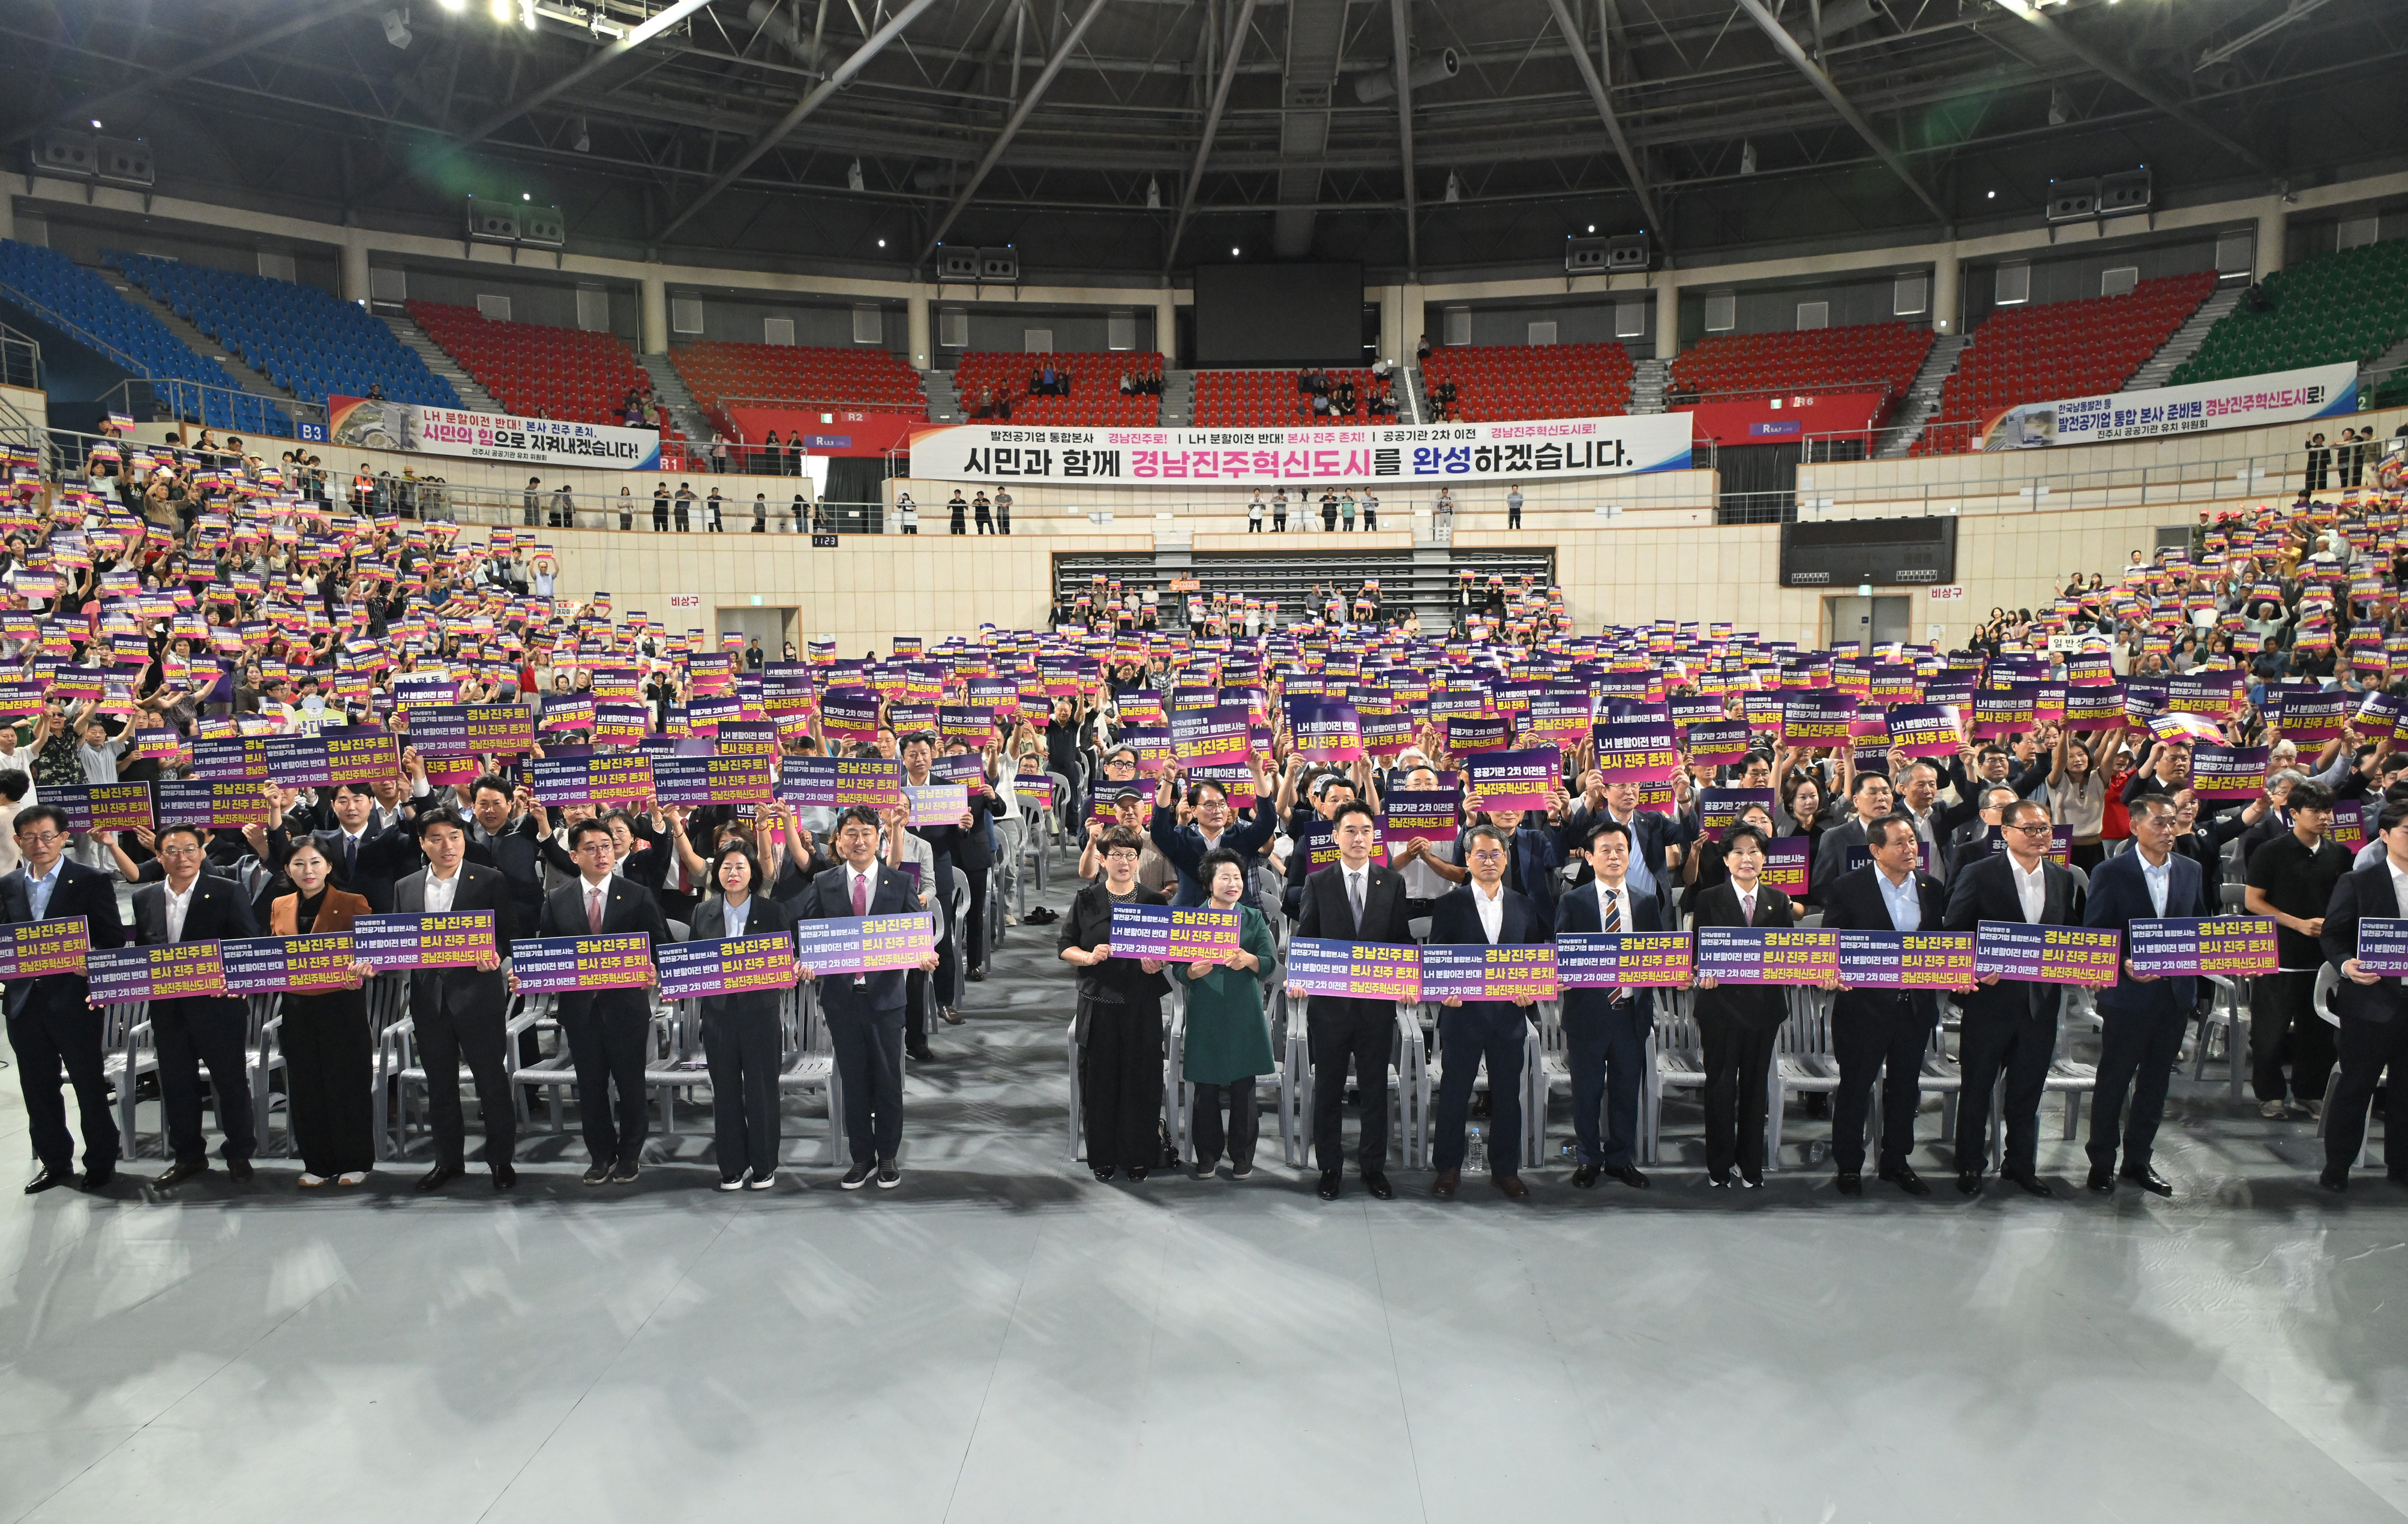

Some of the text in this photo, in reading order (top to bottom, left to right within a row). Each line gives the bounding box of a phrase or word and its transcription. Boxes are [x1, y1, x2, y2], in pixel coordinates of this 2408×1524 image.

[2059, 400, 2111, 413] 한국남동발전 등
[2059, 386, 2324, 433] 발전공기업 통합 본사 준비된 경남진주혁신도시로!
[424, 410, 440, 421] LH
[446, 413, 490, 427] 분할이전
[496, 418, 520, 430] 반대!
[526, 421, 546, 433] 본사
[551, 424, 570, 435] 진주
[2098, 419, 2209, 439] 진주시 공공기관 유치 위원회
[303, 425, 321, 440] B3
[991, 424, 1596, 444] 발전공기업 통합본사 경남진주로! LH 분할이전 반대! 본사 진주 존치! 공공기관 2차 이전 경남진주혁신도시로!
[423, 424, 638, 458] 시민의 힘으로 지켜내겠습니다!
[492, 450, 515, 458] 공공기관
[964, 439, 1633, 478] 시민과 함께 경남진주혁신도시를 완성하겠습니다.
[660, 458, 677, 470] R1
[1932, 588, 1962, 598] 비상구
[671, 596, 699, 606] 비상구
[1975, 711, 2033, 722] 본사 진주 존치!
[1172, 722, 1245, 737] 발전공기업 통합본사는
[1175, 737, 1246, 758] 경남진주로!
[1599, 736, 1671, 748] LH 분할이전 반대!
[1600, 752, 1673, 769] 본사 진주 존치!
[2194, 761, 2265, 772] 발전공기업 통합본사는
[1474, 766, 1546, 777] 공공기관 2차 이전은
[1474, 782, 1549, 795] 경남진주혁신도시로!
[2193, 775, 2263, 789] 경남진주로!
[1389, 803, 1417, 812] 공공기관
[1433, 803, 1454, 811] 이전은
[1389, 817, 1454, 827] 경남진주혁신도시로!
[2199, 921, 2272, 935] 경남진주로!
[659, 937, 788, 963] 발전공기업 통합본사는 경남진주로!
[2133, 940, 2274, 953] LH 분할이전 반대! 본사 진주 존치!
[1486, 949, 1554, 962] 경남진주로!
[673, 966, 701, 976] 분할이전
[703, 964, 719, 973] 반대!
[722, 959, 742, 973] 본사
[744, 957, 764, 970] 진주
[767, 955, 790, 967] 존치!
[2134, 957, 2275, 970] 공공기관 2차 이전은 경남진주혁신도시로!
[1436, 970, 1464, 978] 분할이전
[1465, 970, 1482, 978] 반대!
[1485, 968, 1506, 979] 본사
[1508, 968, 1528, 979] 진주
[1531, 967, 1554, 979] 존치!
[661, 984, 688, 994] 공공기관
[702, 980, 721, 989] 이전은
[724, 971, 792, 988] 경남진주혁신도시로!
[1423, 986, 1449, 995] 공공기관
[1485, 985, 1554, 996] 경남진주혁신도시로!
